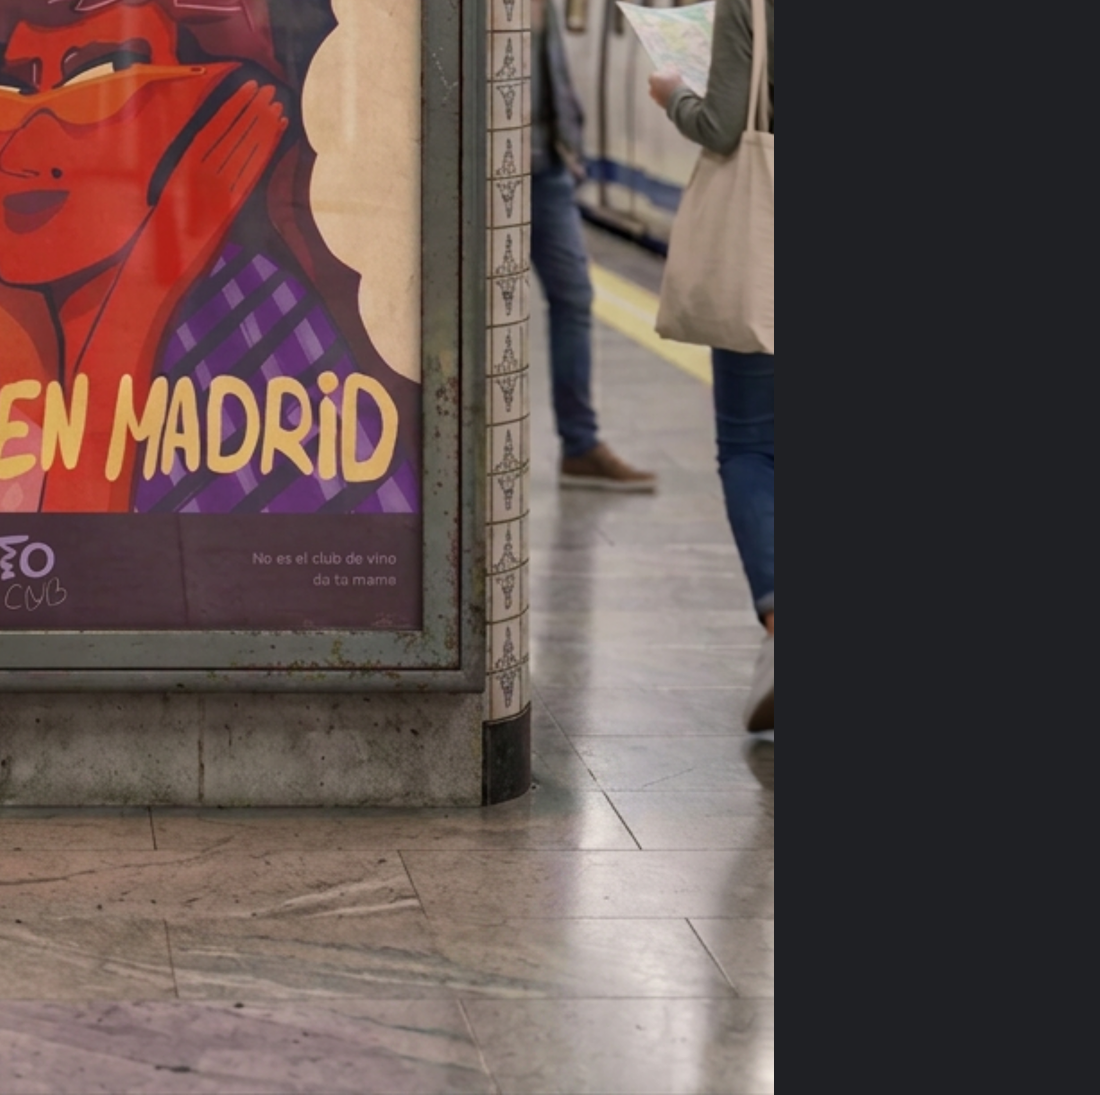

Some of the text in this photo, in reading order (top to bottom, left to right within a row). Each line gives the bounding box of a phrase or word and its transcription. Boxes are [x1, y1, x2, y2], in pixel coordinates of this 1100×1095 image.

[252, 551, 397, 565] No es el club de vino
